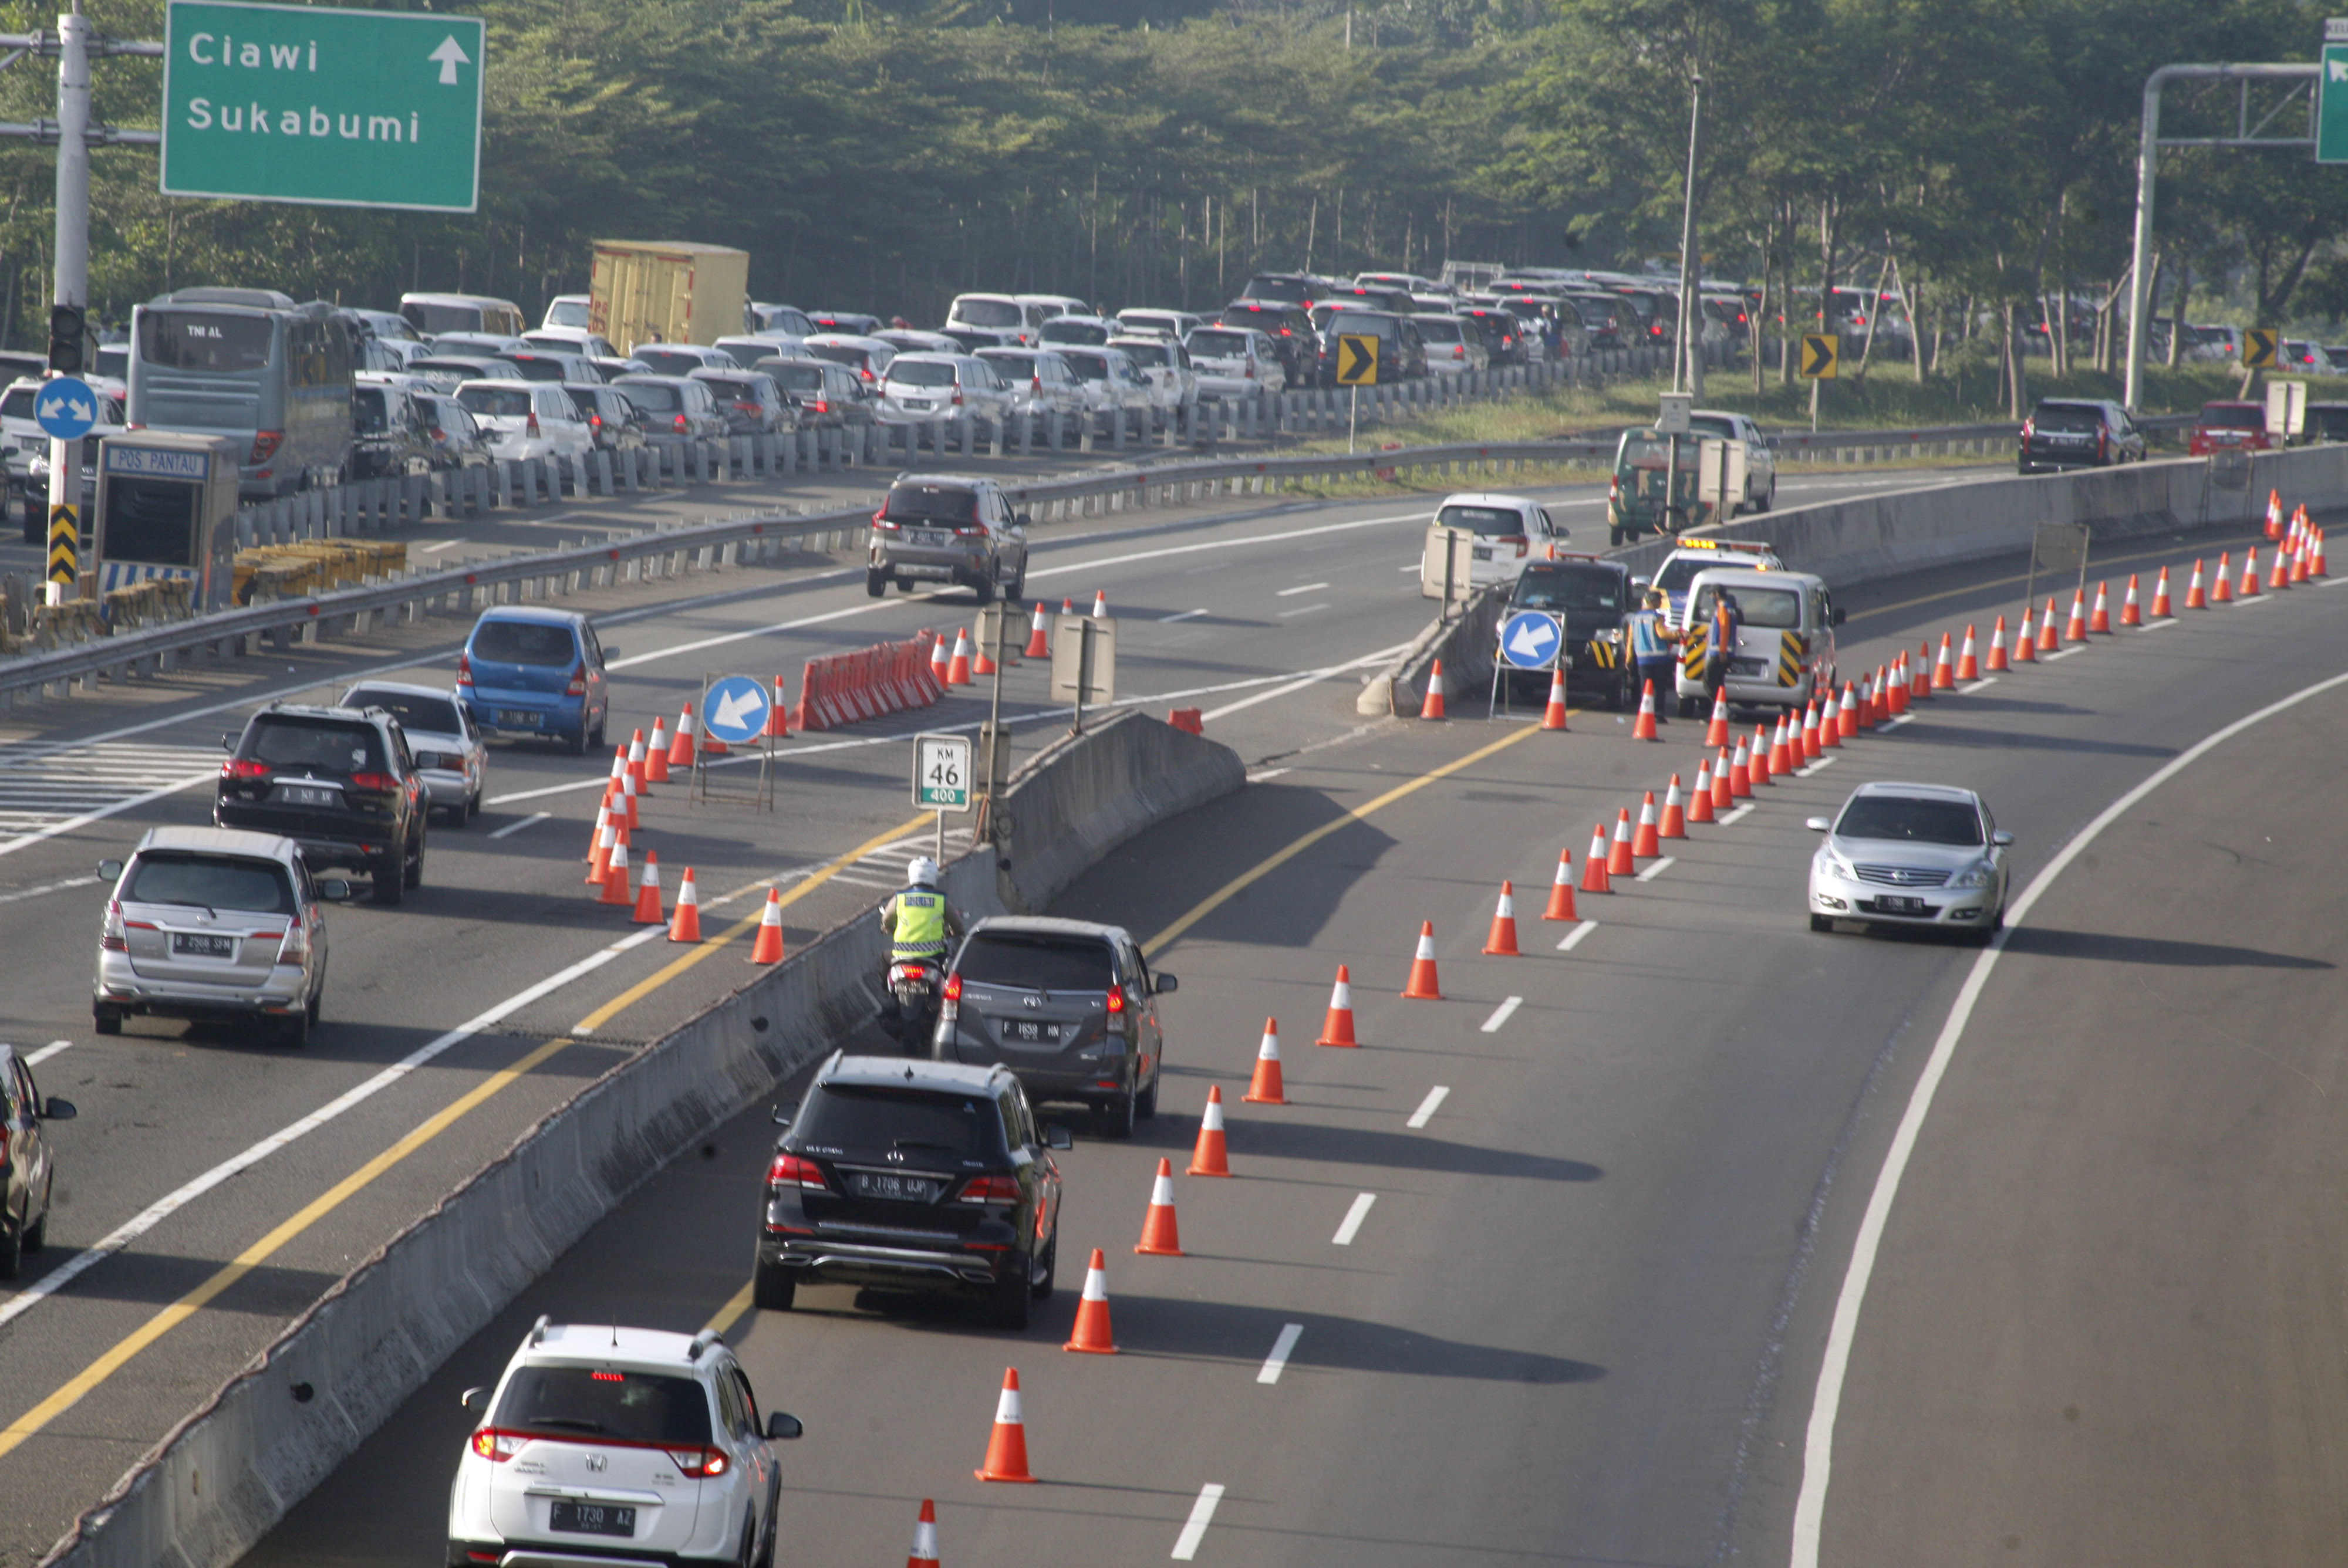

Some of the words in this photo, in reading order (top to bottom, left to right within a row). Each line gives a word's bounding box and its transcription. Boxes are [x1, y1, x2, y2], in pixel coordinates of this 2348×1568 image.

[188, 32, 318, 72] Ciawi
[187, 97, 419, 143] Sukabumi
[187, 325, 205, 337] TNI
[208, 326, 223, 339] AL
[119, 449, 142, 468] POS
[150, 451, 197, 473] PANTAU
[937, 747, 954, 761] KM
[929, 762, 959, 786] 46
[930, 788, 956, 803] 400
[862, 1174, 869, 1189] B
[878, 1175, 900, 1191] 1706
[554, 1503, 561, 1520] F
[576, 1505, 604, 1524] 1730
[617, 1509, 632, 1526] AZ
